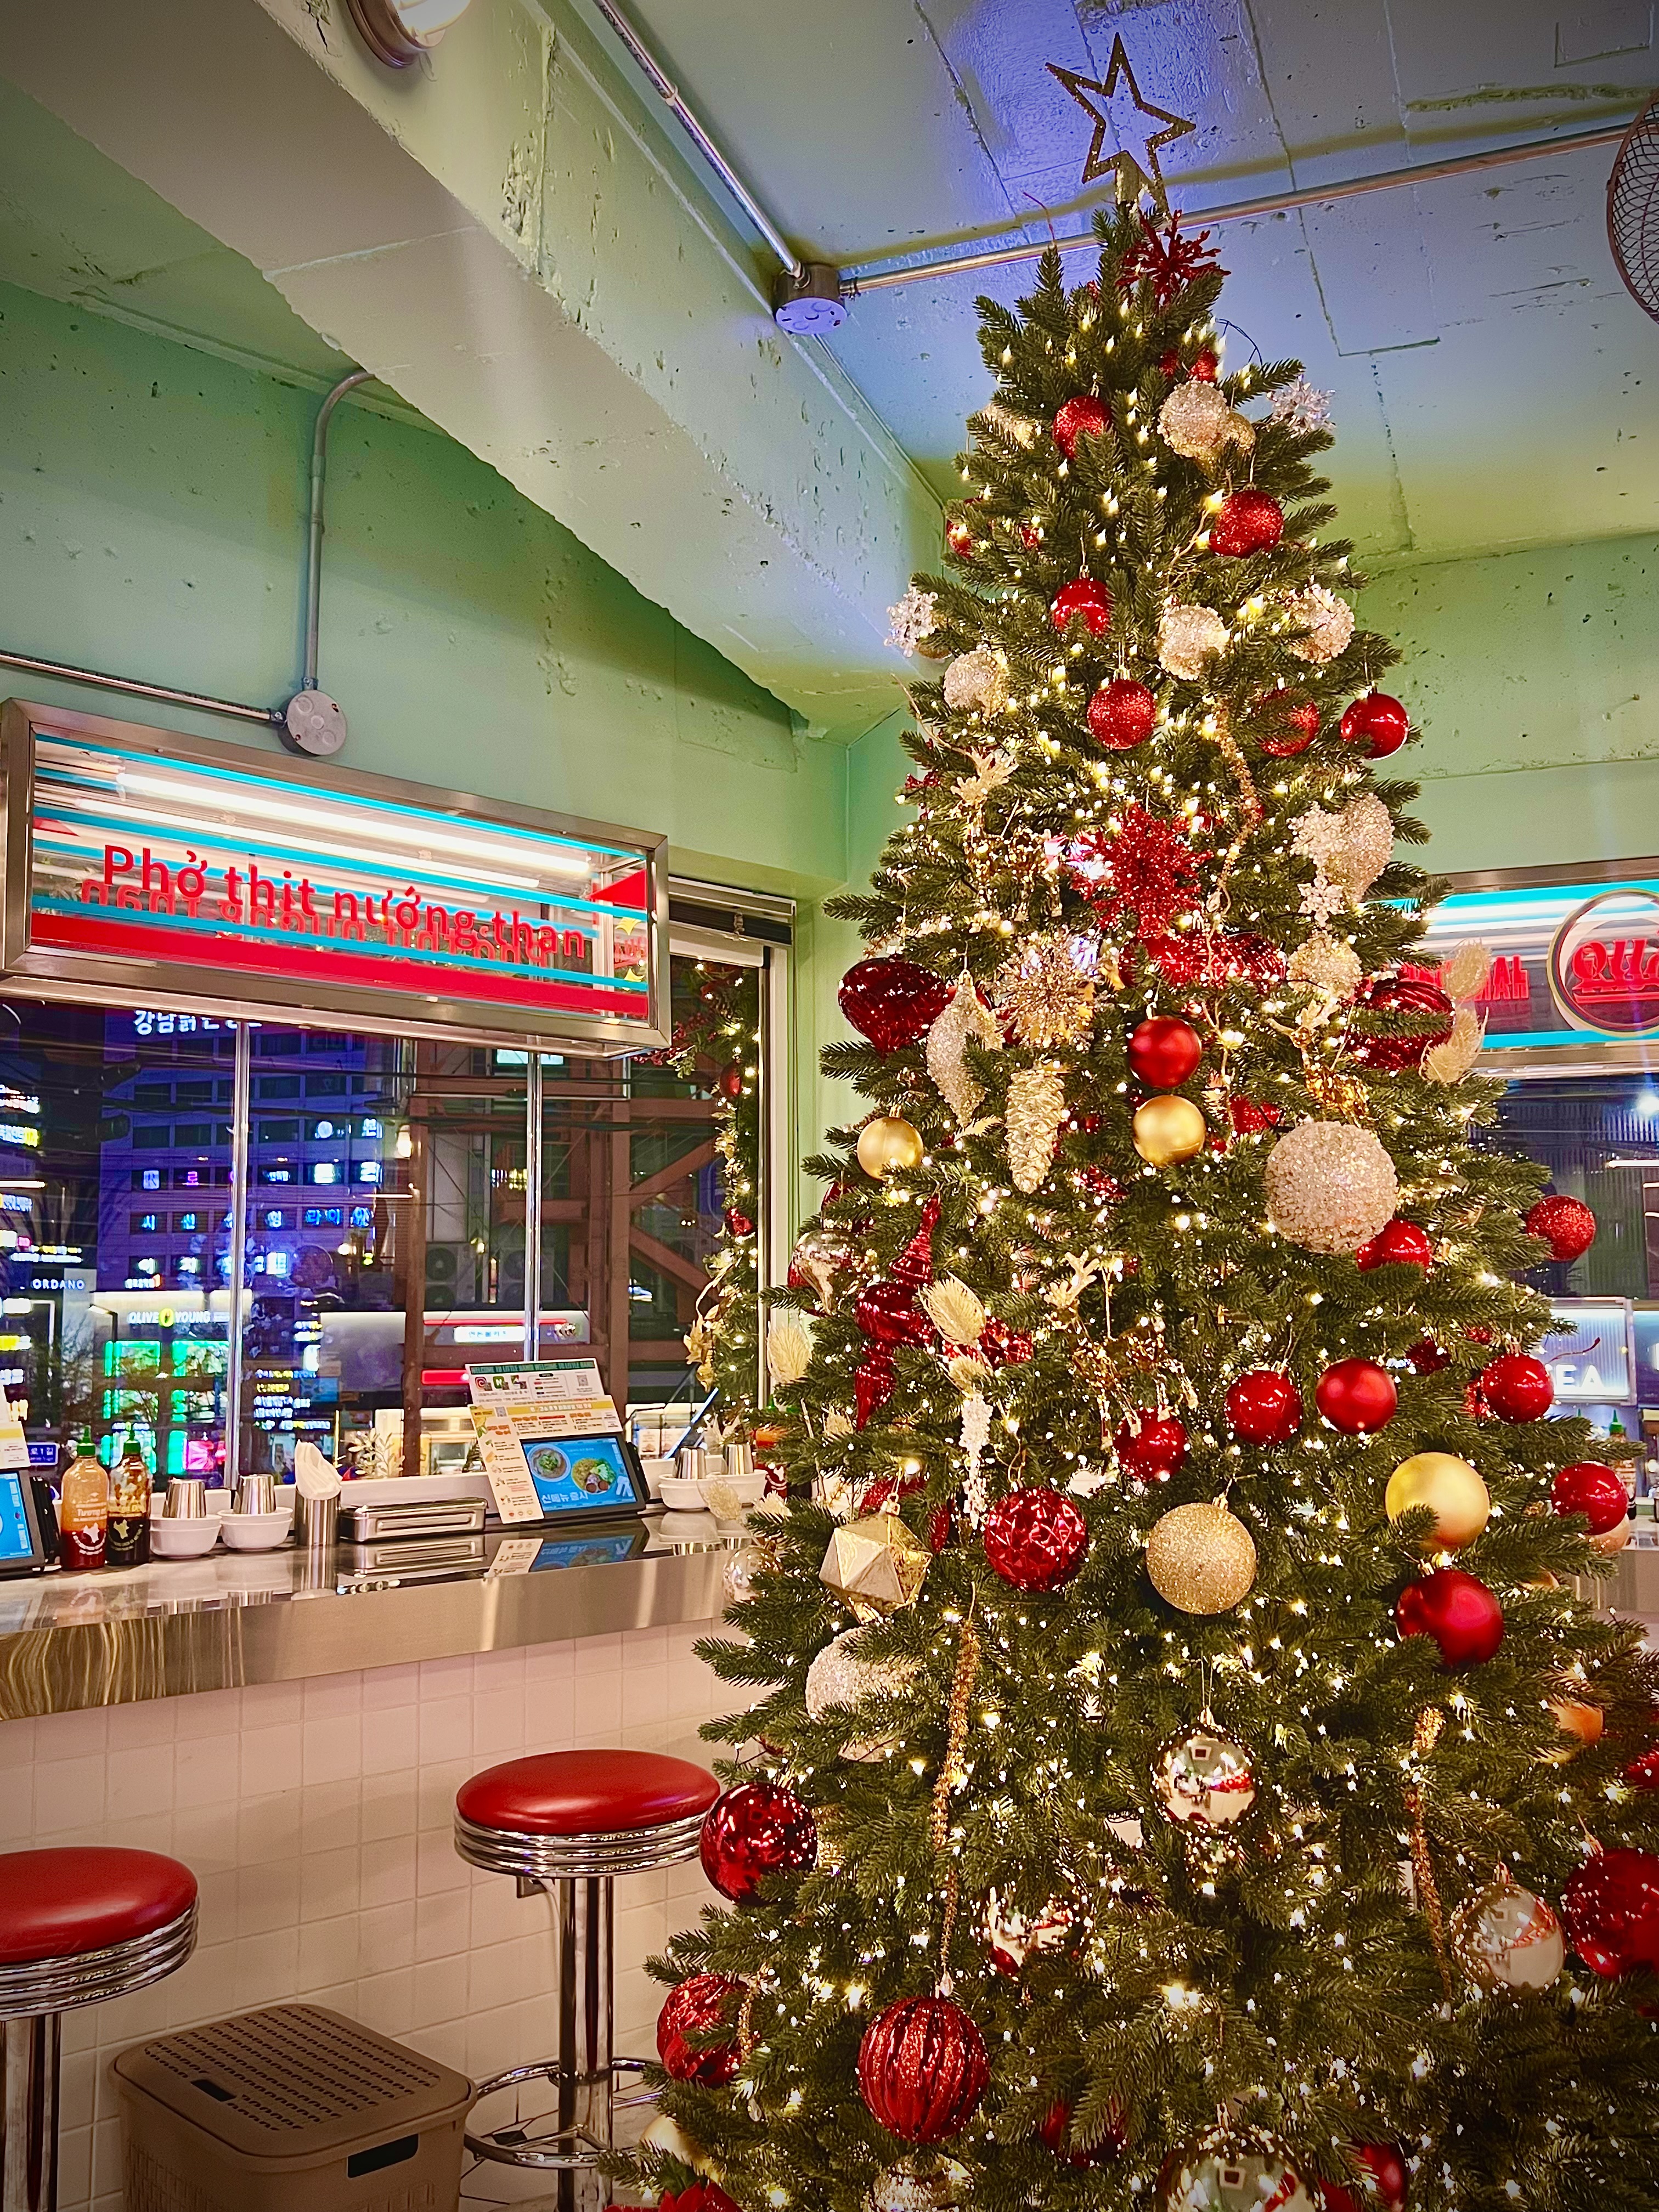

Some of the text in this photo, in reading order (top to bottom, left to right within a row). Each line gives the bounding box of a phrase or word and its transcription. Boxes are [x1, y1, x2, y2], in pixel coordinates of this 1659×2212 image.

[104, 844, 208, 898] Phở
[334, 886, 476, 951] nướng
[492, 910, 584, 958] than
[127, 1312, 159, 1324] OLIVE
[175, 1311, 211, 1324] YOUNG
[1546, 1364, 1605, 1388] EA
